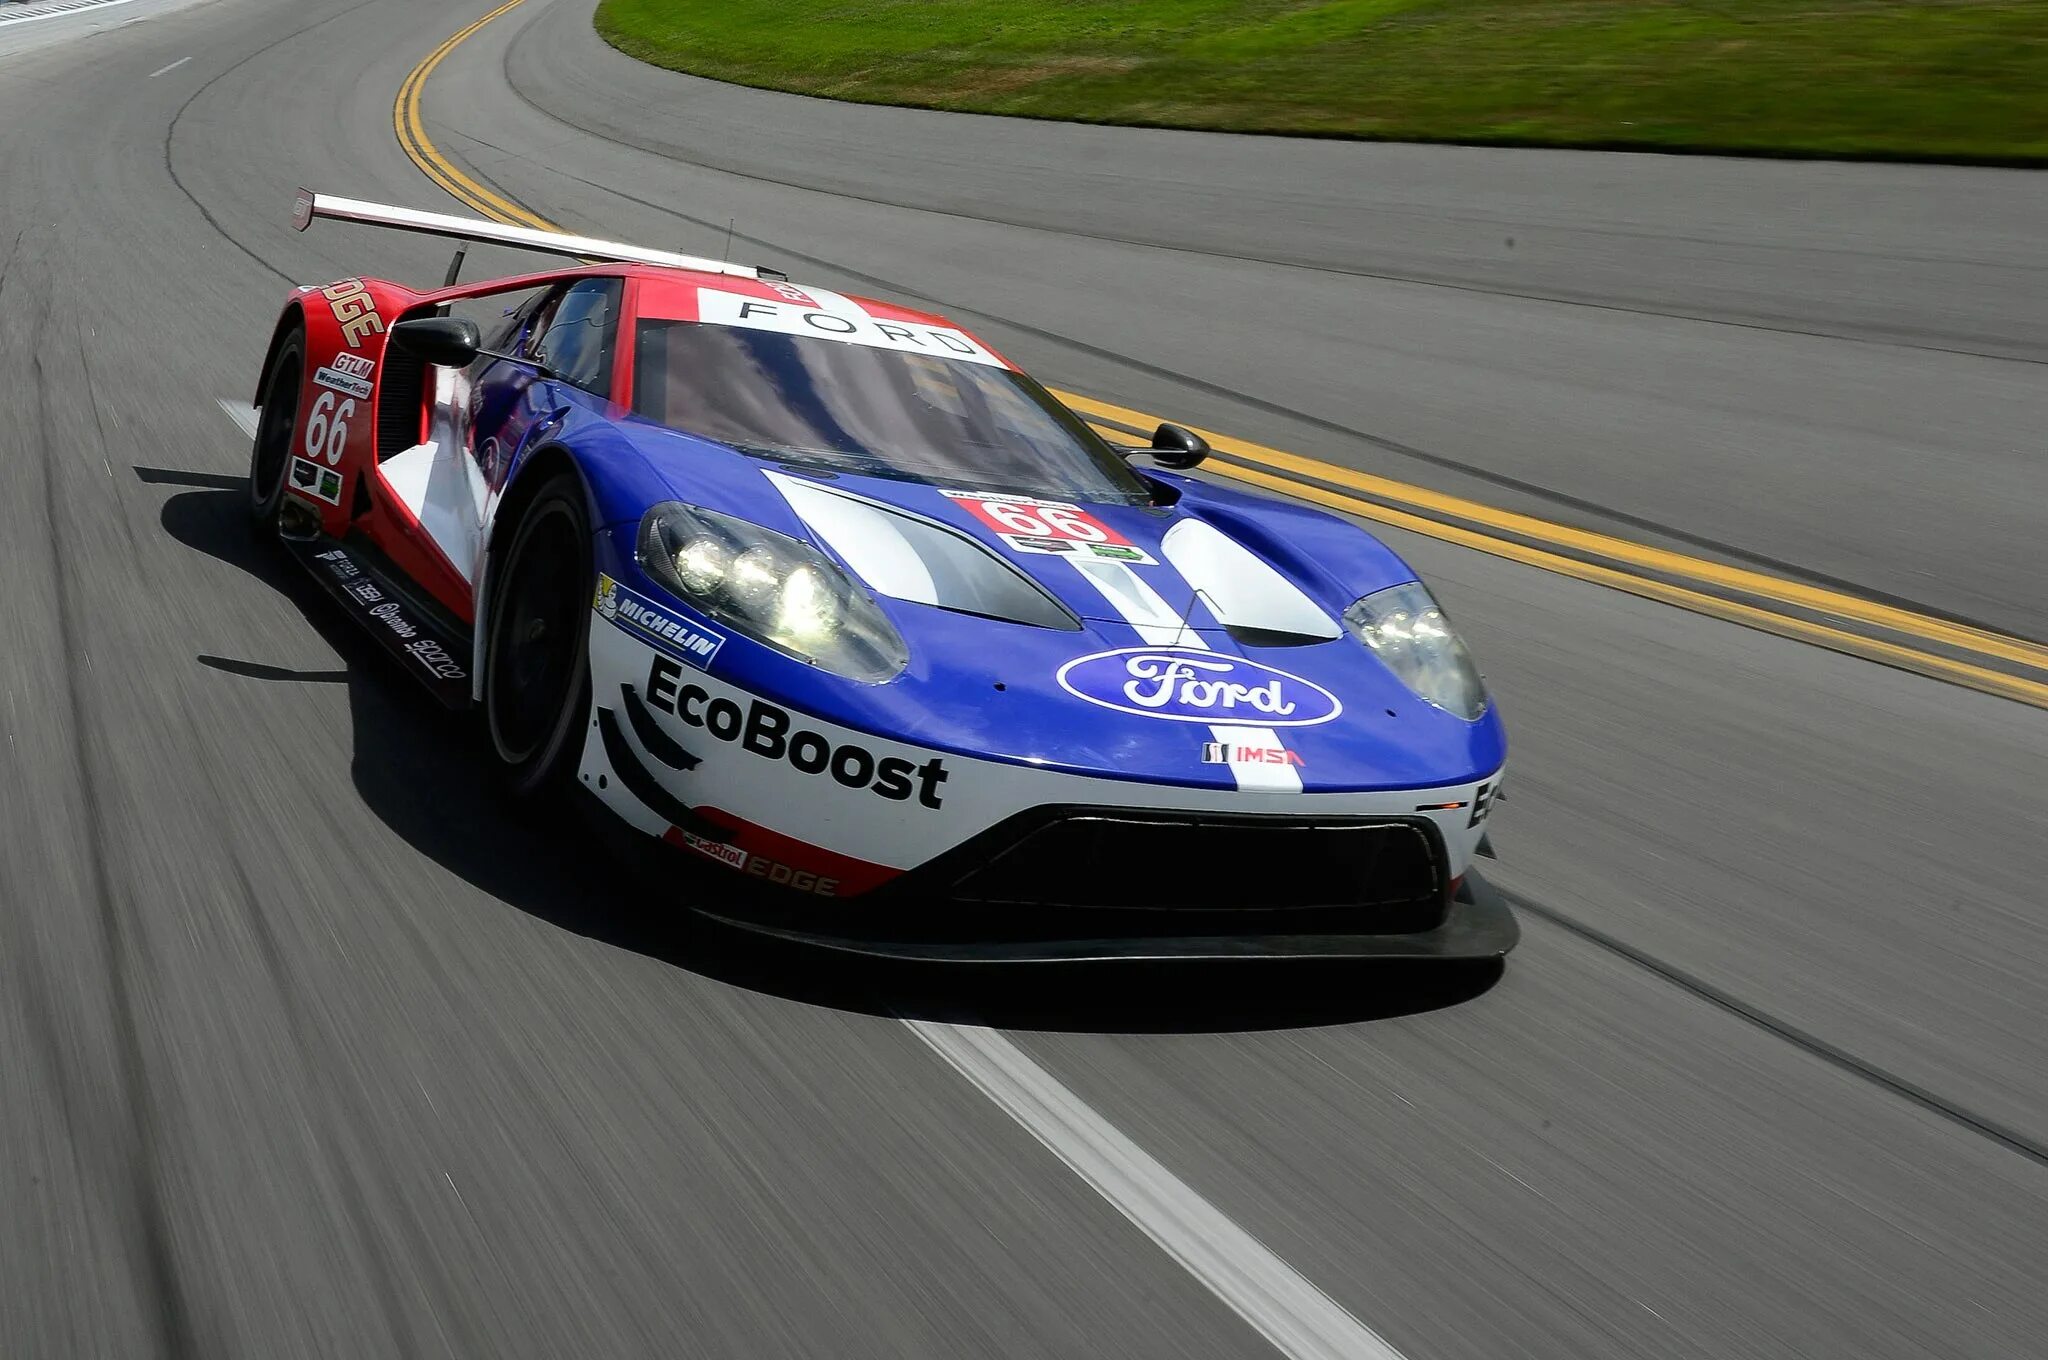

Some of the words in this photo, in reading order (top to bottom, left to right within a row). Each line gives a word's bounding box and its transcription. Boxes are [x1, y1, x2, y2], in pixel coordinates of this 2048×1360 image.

[321, 277, 385, 348] DGE
[739, 302, 976, 355] FORD
[318, 371, 370, 394] WeatherTech
[335, 354, 372, 378] GTLM
[305, 391, 355, 466] 66
[981, 501, 1108, 543] 66
[619, 598, 717, 656] MICHELIN
[413, 640, 467, 678] sparco
[1123, 655, 1296, 716] Ford
[646, 654, 949, 811] EcoBoost
[1236, 746, 1305, 767] IMSA
[696, 837, 742, 866] Castrol
[749, 856, 840, 897] EDGE
